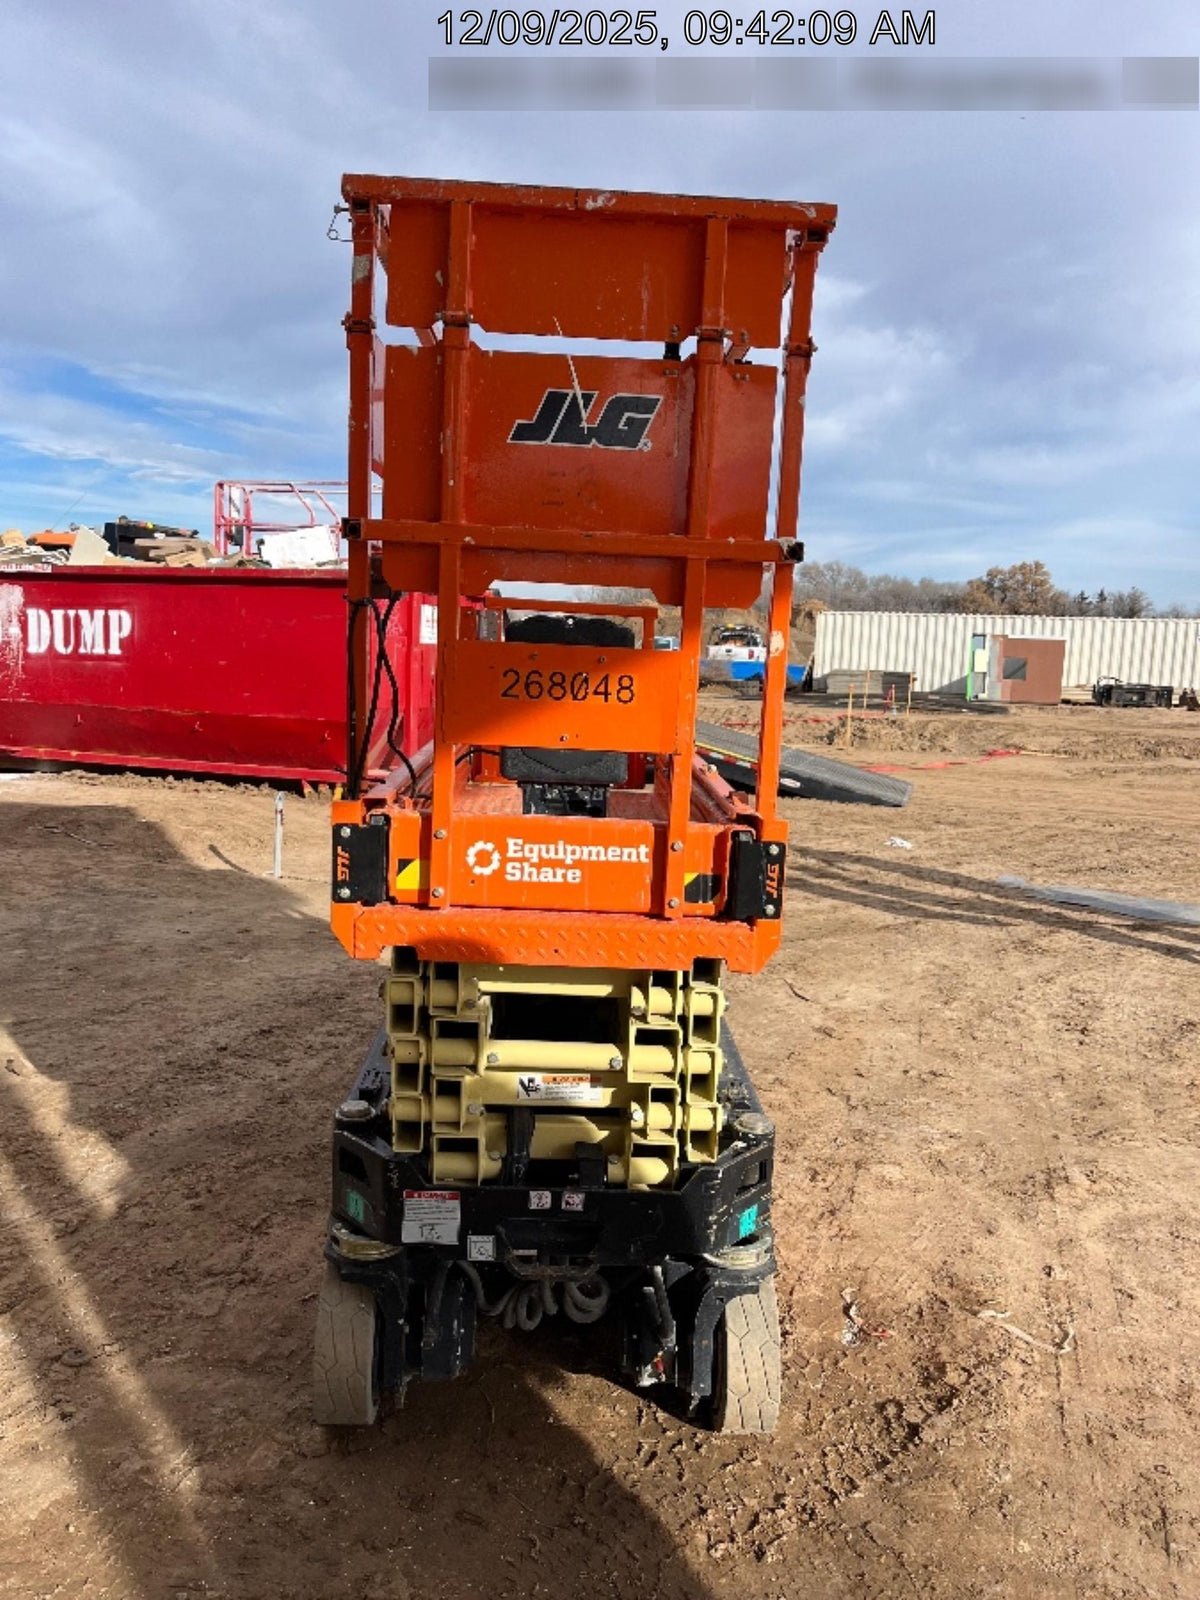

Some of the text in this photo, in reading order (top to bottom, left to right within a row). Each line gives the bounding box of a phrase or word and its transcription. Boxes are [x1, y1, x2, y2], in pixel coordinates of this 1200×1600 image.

[507, 388, 663, 451] JLG
[501, 668, 635, 704] 268048
[337, 845, 349, 881] JLG
[506, 837, 650, 864] Equipment
[505, 862, 582, 883] Share
[766, 864, 779, 898] JLG
